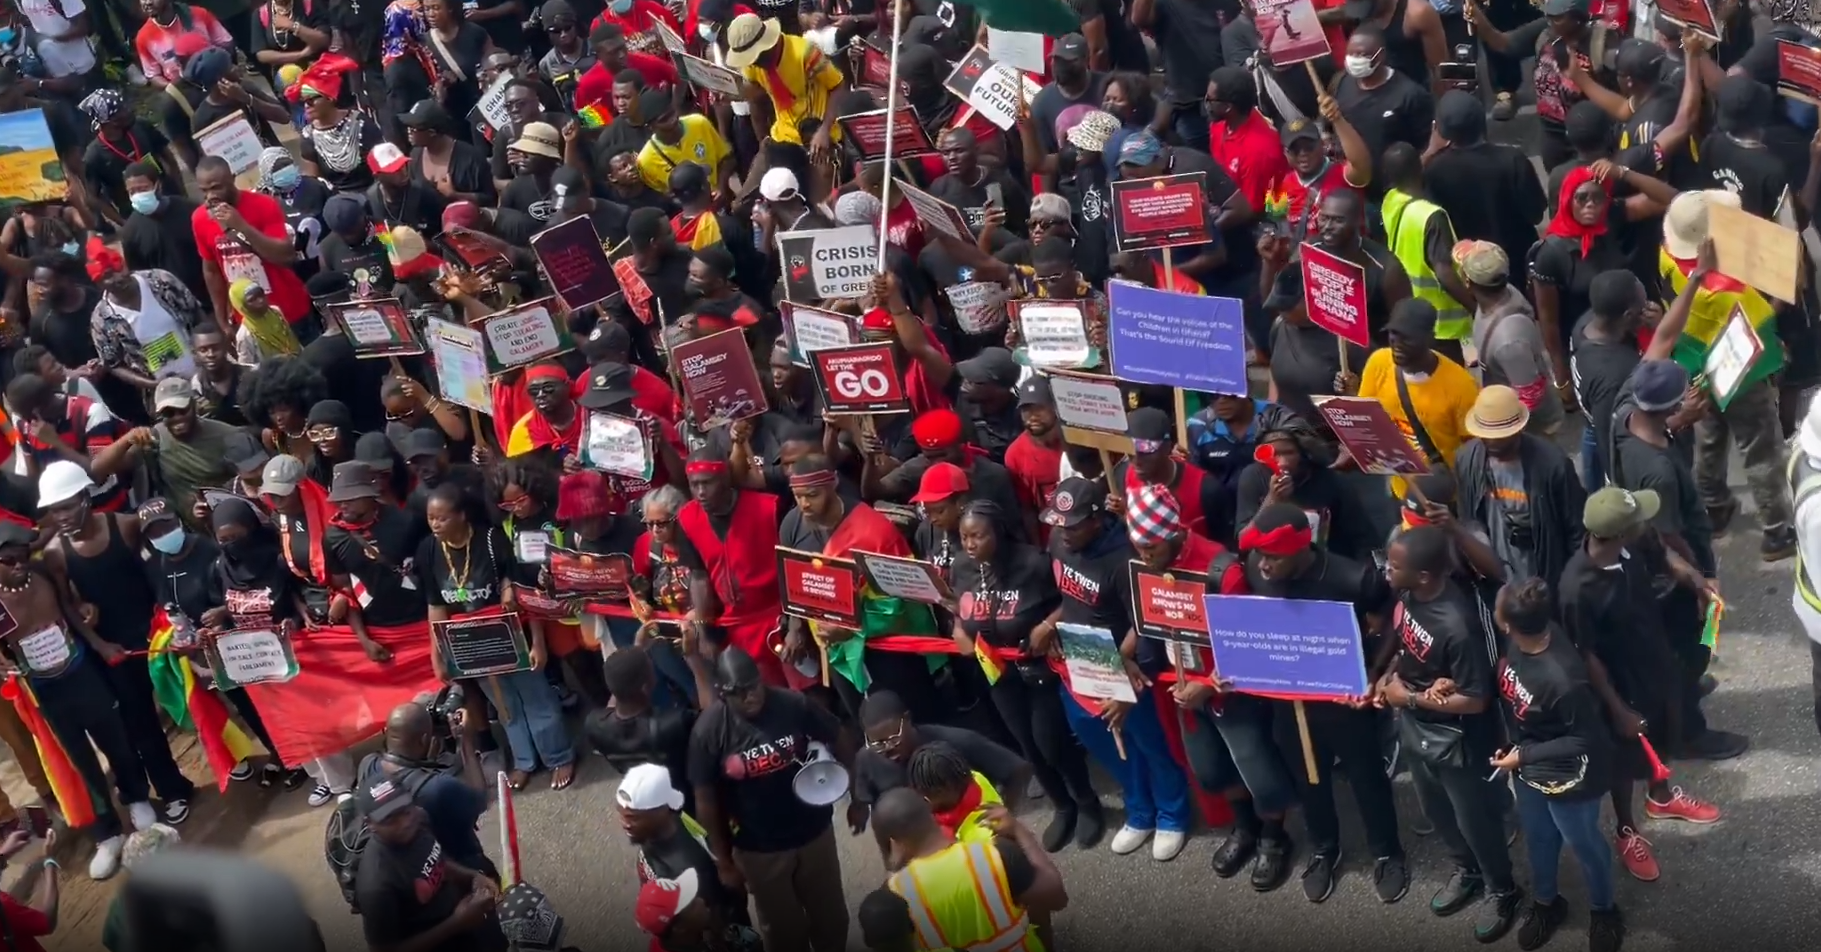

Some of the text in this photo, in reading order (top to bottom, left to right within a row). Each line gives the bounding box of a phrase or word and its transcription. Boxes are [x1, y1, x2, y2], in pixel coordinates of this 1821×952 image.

[815, 245, 878, 261] CRISIS
[826, 264, 875, 279] BORN
[1308, 261, 1355, 286] GREEDY
[821, 285, 837, 294] OF
[1310, 270, 1354, 297] PEOPLE
[1322, 285, 1345, 302] ARE
[1310, 286, 1358, 316] RUINING
[1116, 307, 1131, 316] Can
[1132, 310, 1147, 319] you
[1148, 312, 1165, 321] hear
[1167, 315, 1180, 323] the
[1181, 319, 1207, 327] voices
[1314, 298, 1356, 324] GHANA
[494, 322, 519, 333] CREATE
[1138, 321, 1170, 333] Children
[1181, 328, 1211, 339] Ghana?
[494, 332, 512, 342] STOP
[510, 333, 538, 347] AND END
[1120, 328, 1143, 339] That's
[1144, 332, 1157, 341] the
[1159, 335, 1183, 346] Sound
[508, 341, 544, 355] GALAMSEY
[681, 353, 704, 366] STOP
[683, 353, 728, 373] GALAMSEY
[686, 366, 707, 378] NOW
[835, 369, 889, 398] GO
[801, 572, 824, 582] EFFECT
[802, 579, 836, 591] GALAMSEY
[809, 587, 836, 598] BEYOND
[1151, 587, 1194, 601] GALAMSEY
[1152, 597, 1196, 612] KNOWS NO
[1165, 610, 1184, 619] NOR
[1215, 629, 1235, 637] How
[1249, 632, 1265, 640] you
[1266, 633, 1290, 642] sleep
[1302, 636, 1325, 644] night
[1327, 637, 1350, 645] when
[1222, 640, 1272, 650] 9-year-olds
[1299, 644, 1326, 654] illegal
[1327, 647, 1347, 656] gold
[1421, 643, 1430, 657] 7
[1269, 654, 1300, 662] mines?
[239, 661, 275, 671] PARLIAMENT
[1519, 701, 1529, 715] 7
